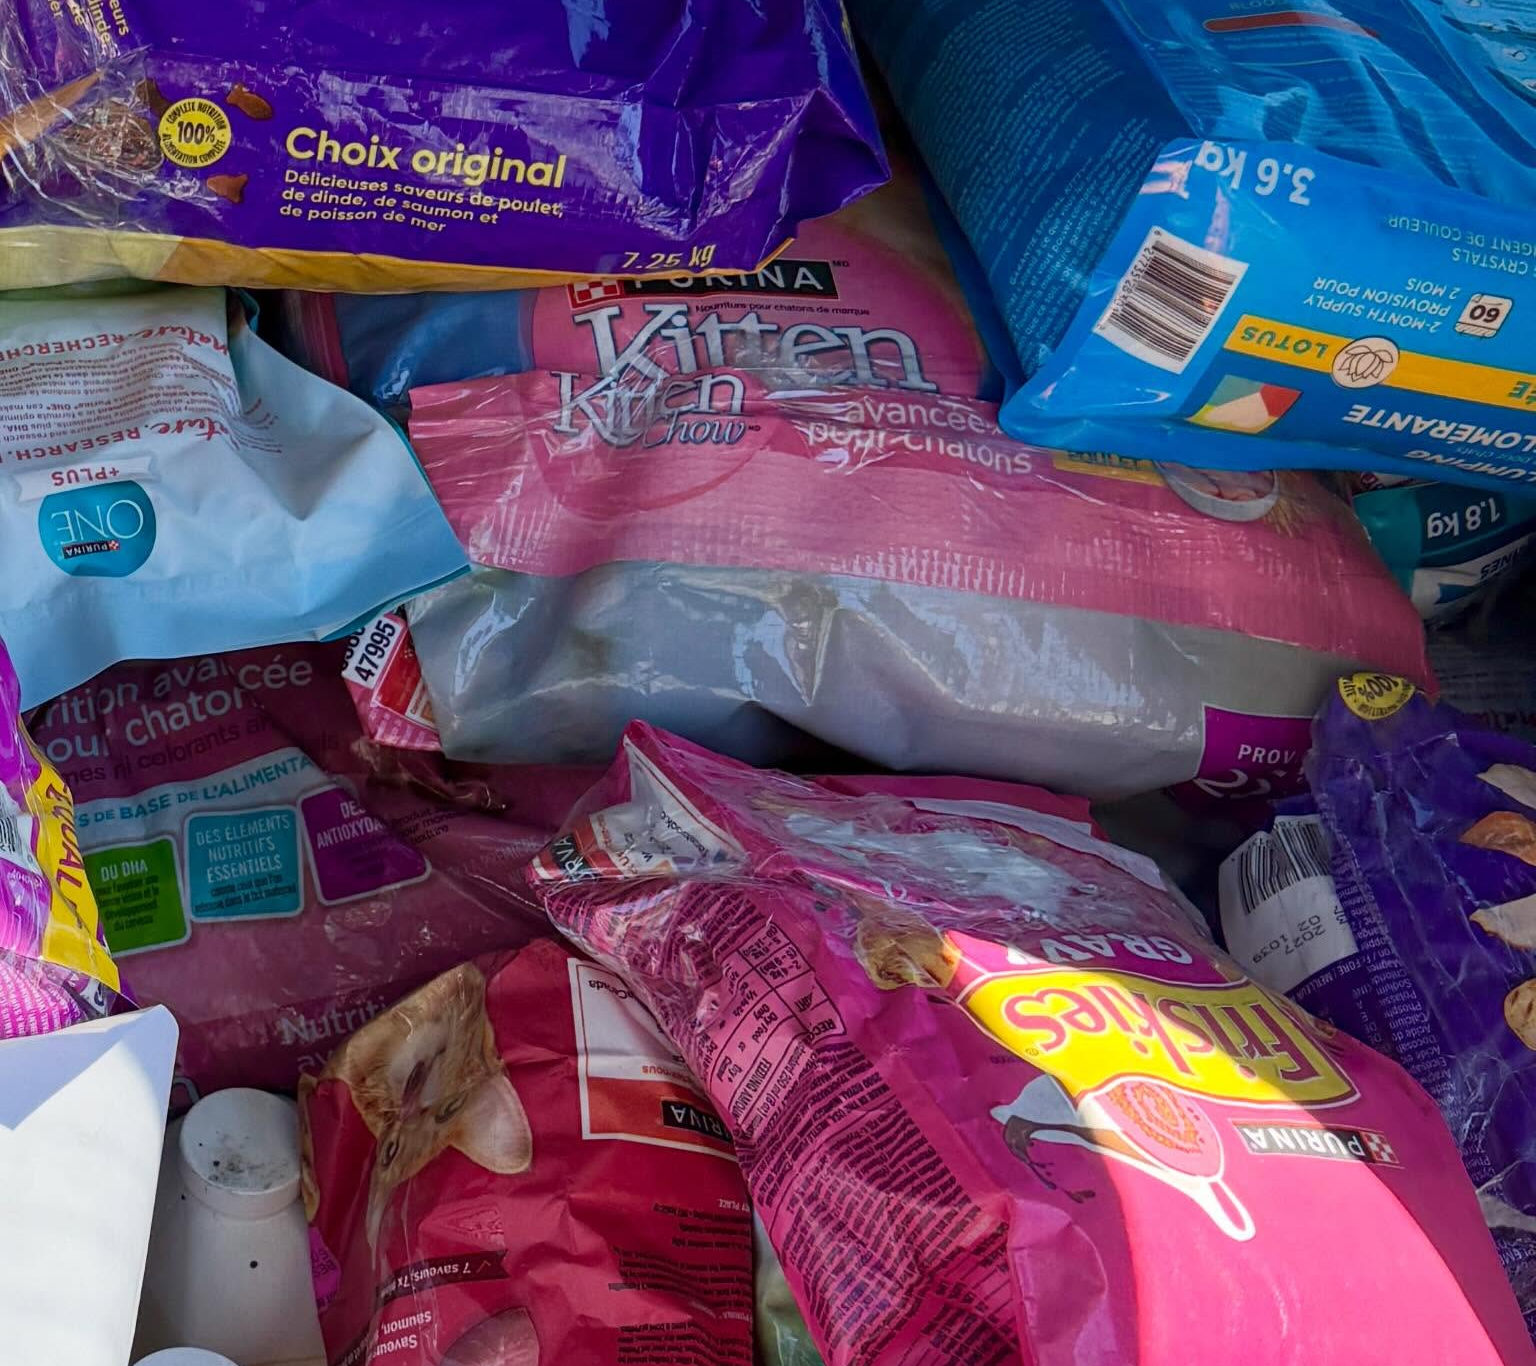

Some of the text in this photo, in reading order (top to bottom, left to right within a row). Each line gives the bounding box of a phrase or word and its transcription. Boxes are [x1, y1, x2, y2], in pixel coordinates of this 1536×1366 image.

[177, 121, 216, 145] 100%
[285, 126, 567, 188] Choix original
[284, 169, 564, 219] Délicieuses saveurs de poulet,
[1255, 157, 1316, 206] 3.6
[279, 203, 447, 233] de poisson de mer
[281, 187, 500, 225] de dinde, de saumon et
[1388, 214, 1463, 241] COULEUR
[621, 241, 716, 270] 7.25 kg
[1452, 247, 1528, 273] CRYSTALS
[1313, 275, 1451, 313] PROVISION POUR
[1407, 277, 1448, 297] MOIS
[695, 302, 871, 319] Nourriture pour chatons marque
[1303, 295, 1443, 334] 2-MONTH SUPPLY
[1468, 305, 1502, 324] 60
[574, 303, 938, 395] Kitten
[1239, 325, 1329, 360] LOTUS
[550, 367, 748, 437] Kitten
[1344, 402, 1536, 451] LOMÉRANTE
[8, 428, 141, 462] RESEARCH.
[50, 465, 121, 488] +PLUS
[50, 499, 144, 540] ONE
[1426, 496, 1502, 542] 1.8 kg
[64, 542, 109, 558] PURINA
[354, 617, 399, 687] 47995
[119, 756, 314, 819] BASE DE L'ALIMENTA
[195, 829, 222, 847] DES
[208, 837, 277, 863] NUTRITIFS
[100, 858, 149, 883] DU DHA
[206, 855, 283, 885] ESSENTIELS
[1251, 936, 1289, 963] 1039
[1283, 924, 1326, 954] 2027
[281, 999, 385, 1045] Nutriti
[1004, 984, 1330, 1084] Friskies
[1245, 1127, 1365, 1161] PURINA
